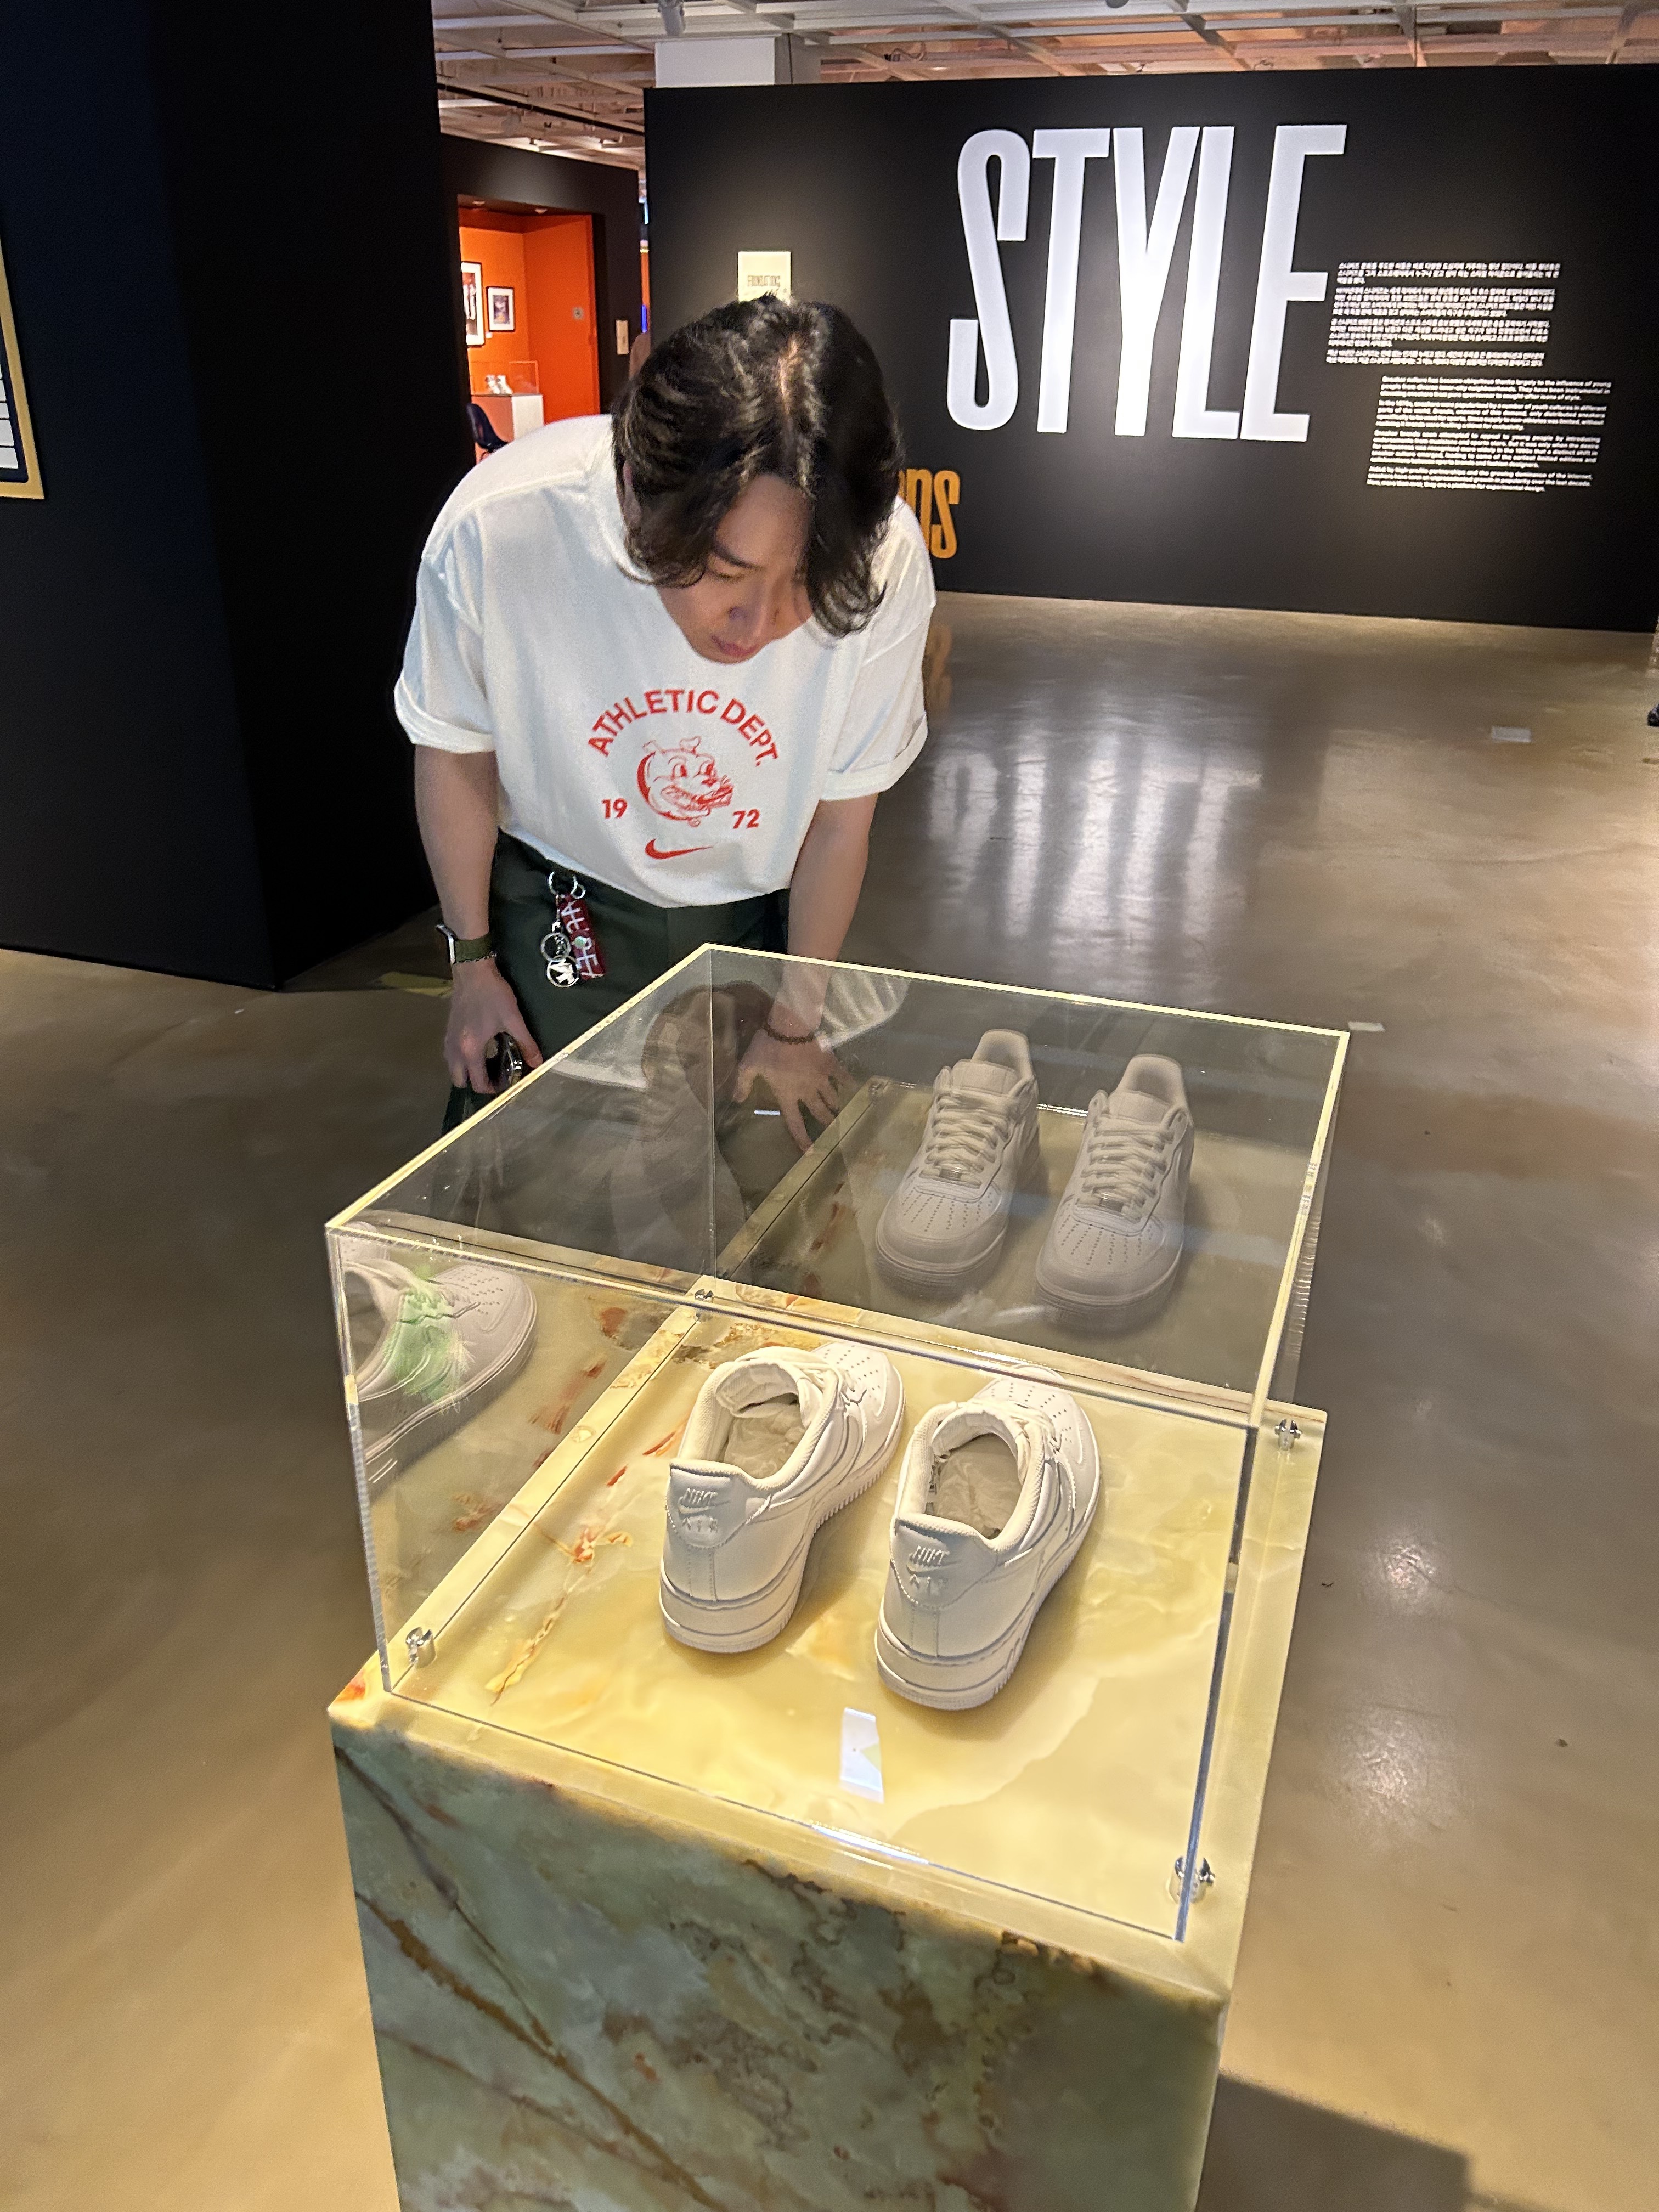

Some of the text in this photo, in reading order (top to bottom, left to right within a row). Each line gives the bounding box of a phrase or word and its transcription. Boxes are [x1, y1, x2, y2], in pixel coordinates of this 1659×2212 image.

[946, 125, 1347, 442] STYLE
[588, 689, 778, 766] ATHLETIC DEPT.
[603, 798, 628, 819] 19
[733, 809, 760, 829] 72
